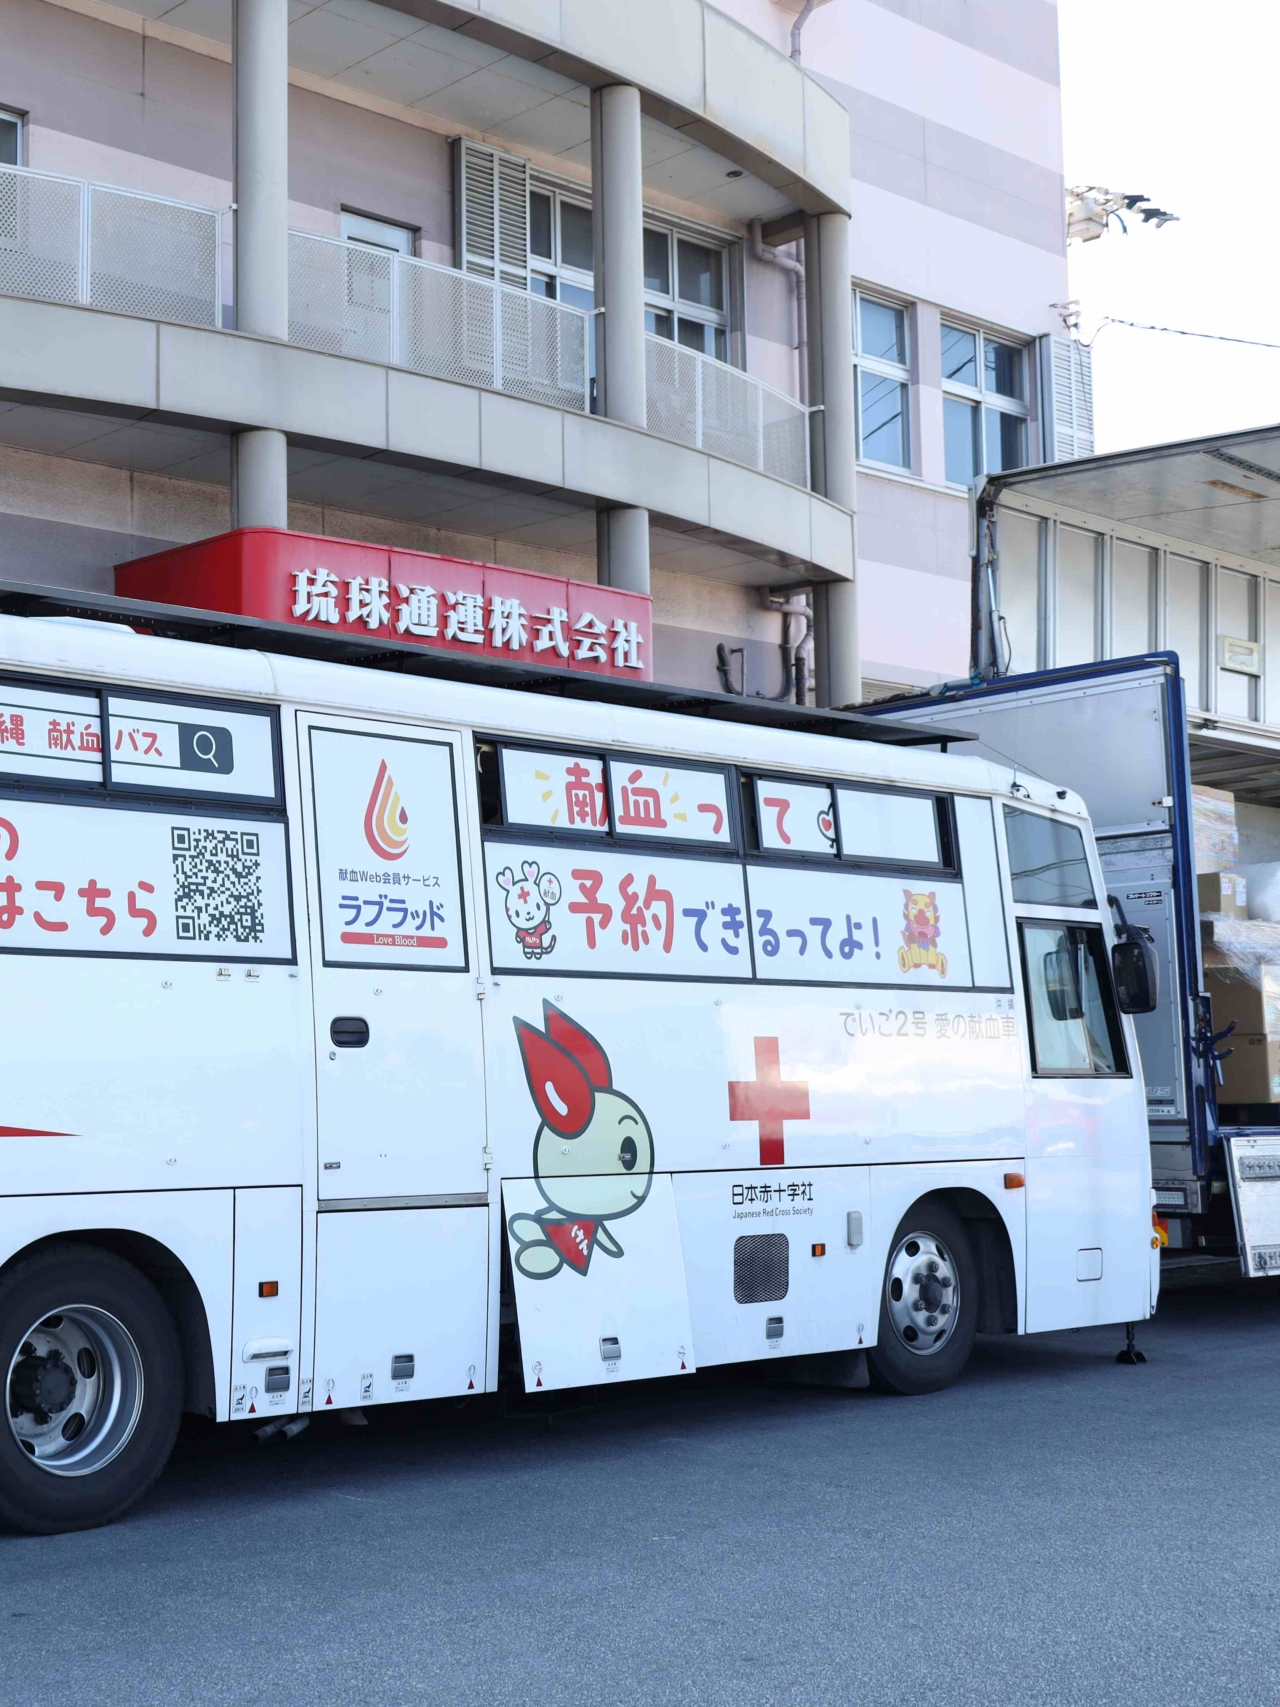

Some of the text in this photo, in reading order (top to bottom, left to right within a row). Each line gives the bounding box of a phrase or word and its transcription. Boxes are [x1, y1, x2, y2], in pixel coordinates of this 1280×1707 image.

[291, 567, 644, 669] 琉球通運株式会社
[338, 868, 441, 888] 献血Web会員サービス
[338, 893, 445, 931] ラブラッド
[373, 934, 417, 946] Love Blood
[732, 1181, 813, 1205] 日本赤十字社
[733, 1206, 813, 1220] Japanese Red Cross Society
